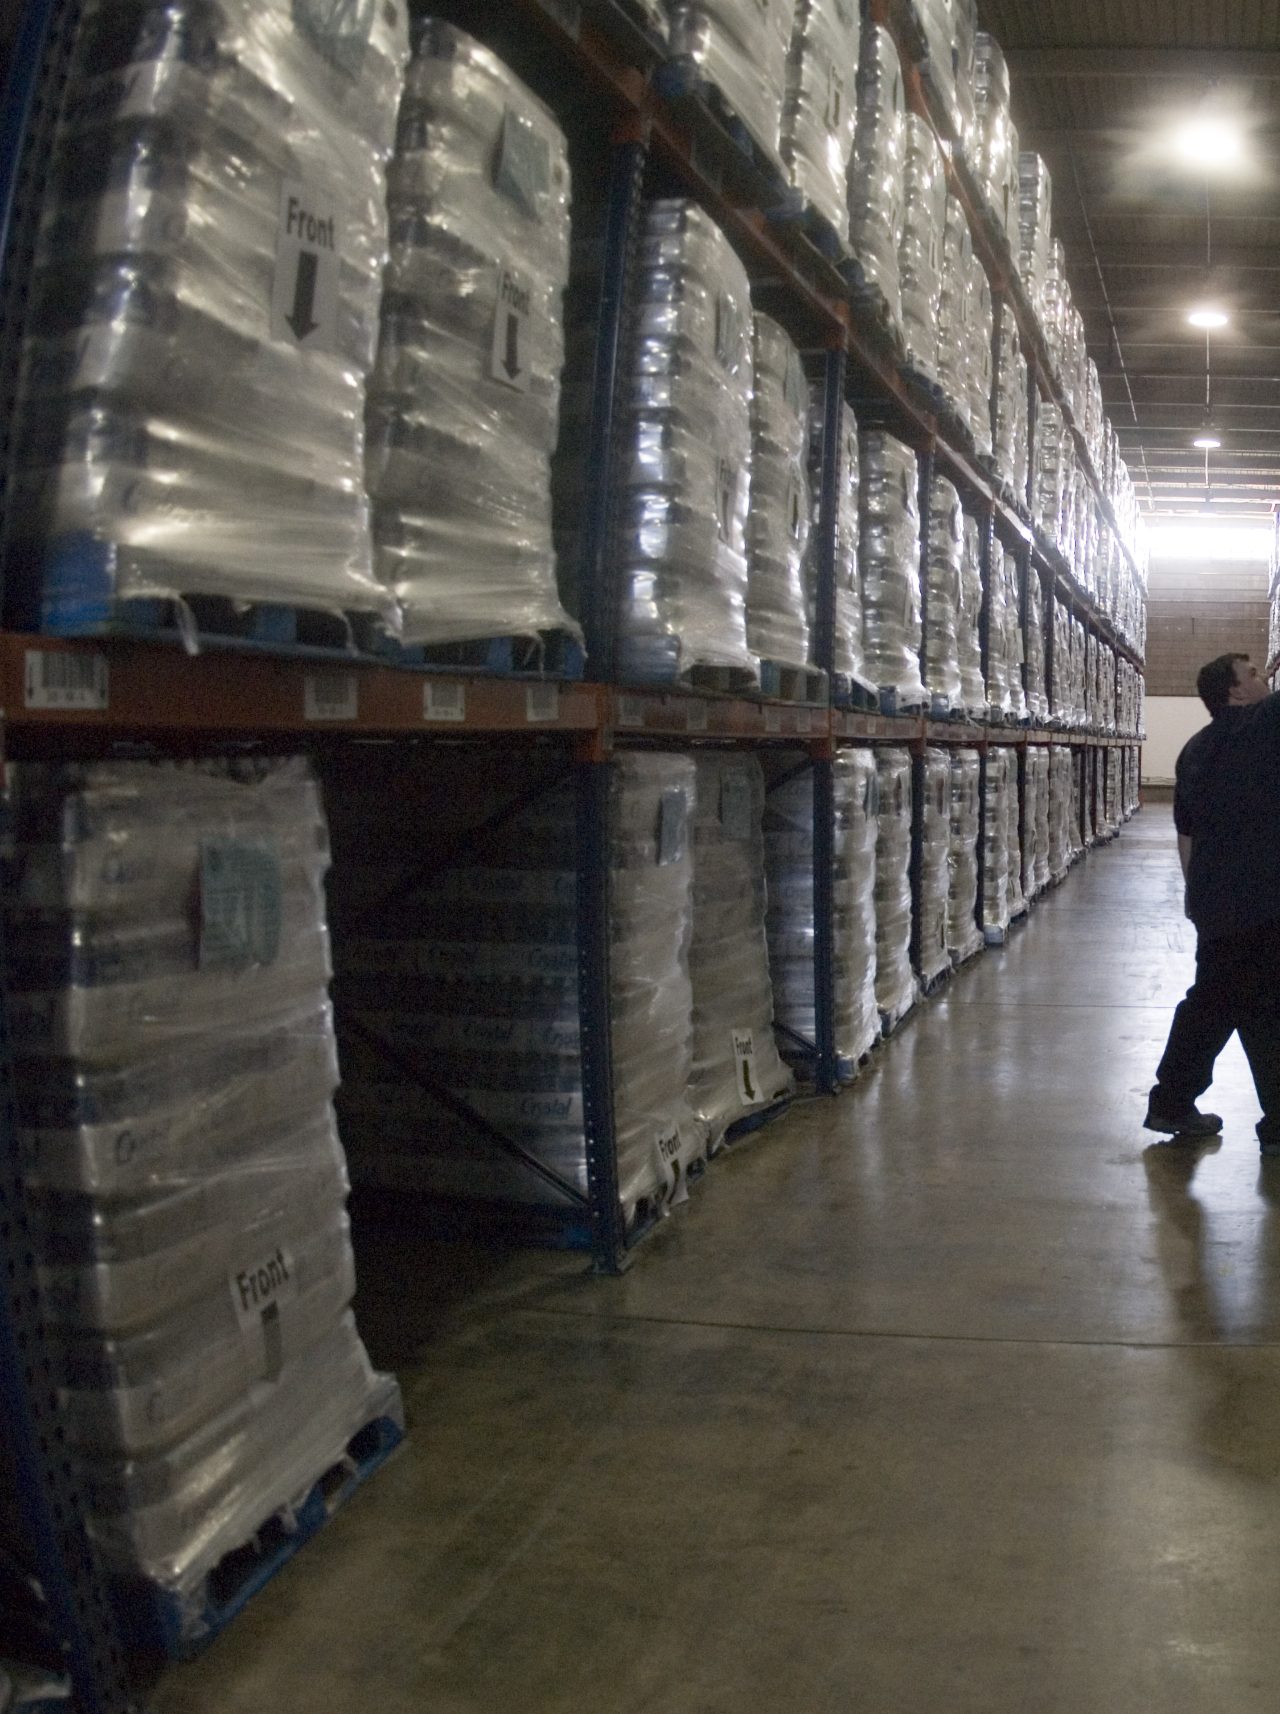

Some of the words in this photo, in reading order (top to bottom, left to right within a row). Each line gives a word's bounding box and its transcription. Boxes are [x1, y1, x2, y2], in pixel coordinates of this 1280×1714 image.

[285, 197, 335, 251] Front
[735, 1036, 752, 1056] Front
[659, 1129, 681, 1161] Front
[236, 1247, 290, 1312] Front
